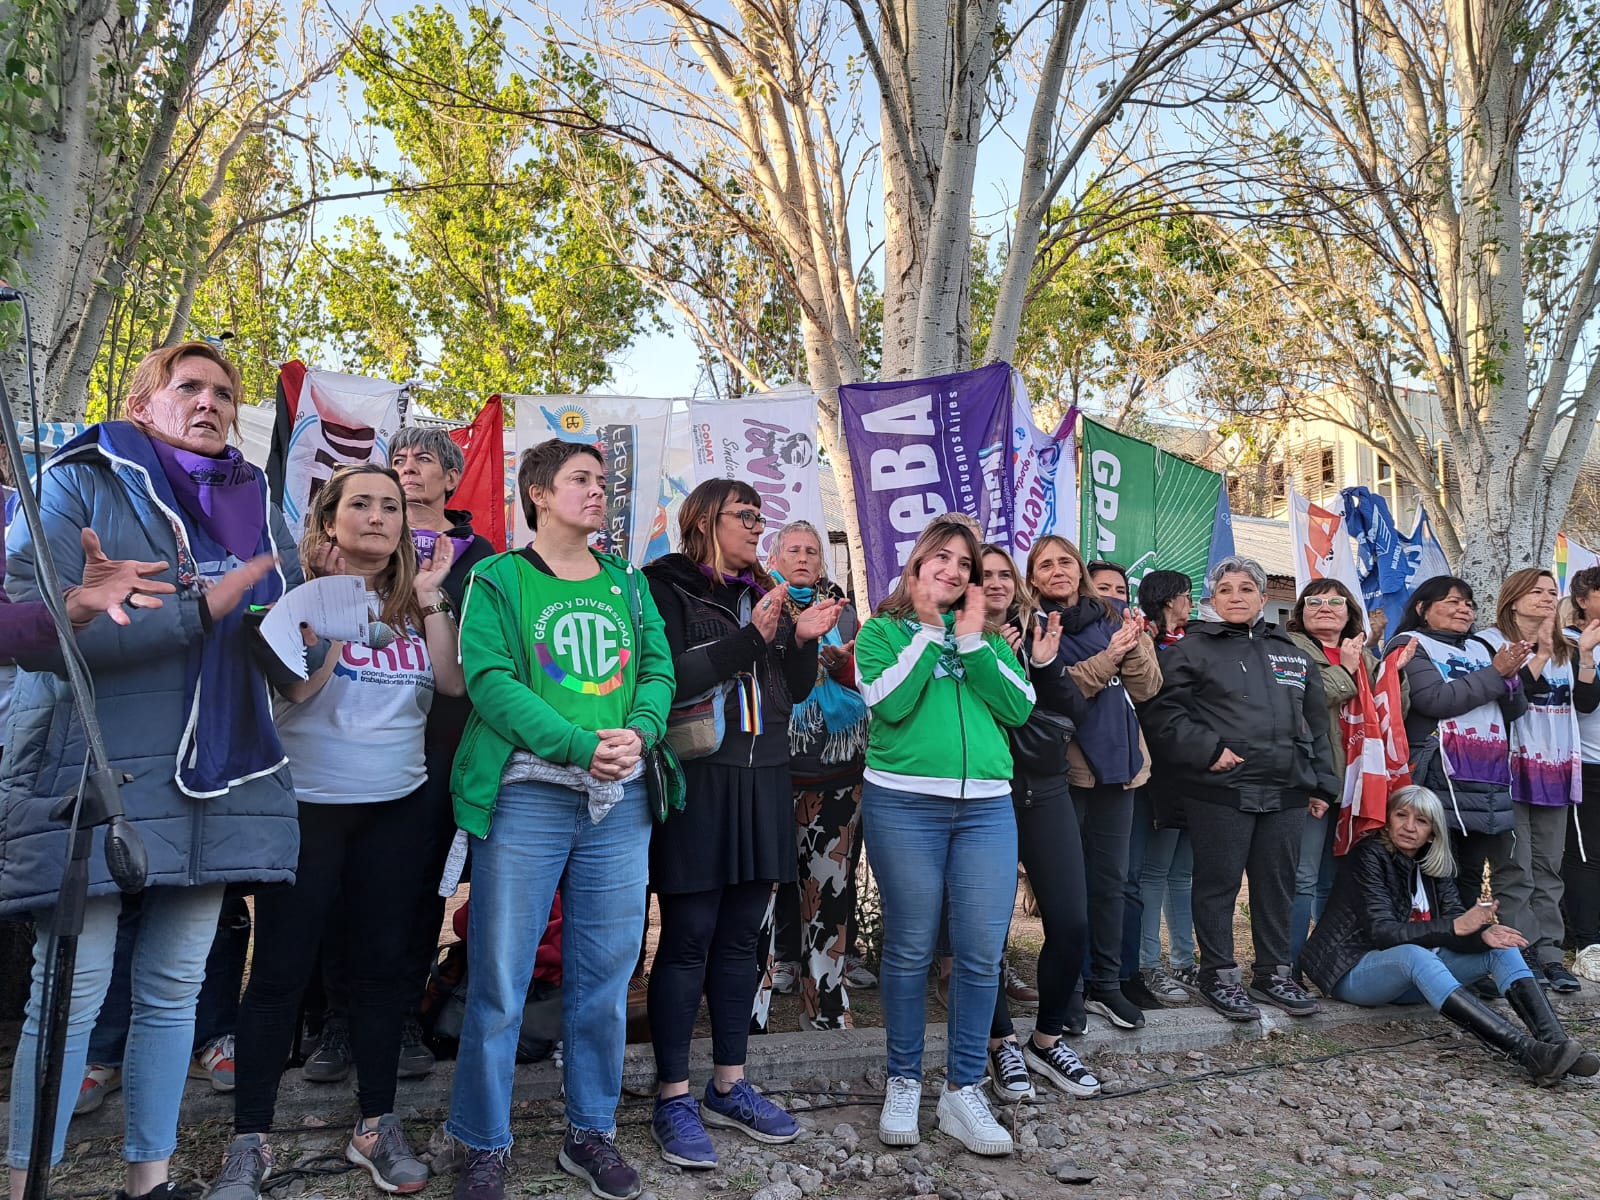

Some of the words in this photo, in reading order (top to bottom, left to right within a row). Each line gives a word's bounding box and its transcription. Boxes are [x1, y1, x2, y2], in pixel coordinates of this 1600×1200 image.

[722, 438, 740, 480] Sindica
[1091, 449, 1121, 560] GRA
[534, 602, 564, 640] GÉNERO
[565, 600, 572, 609] y
[575, 597, 631, 647] DIVERSIDAD
[553, 611, 620, 678] ATE
